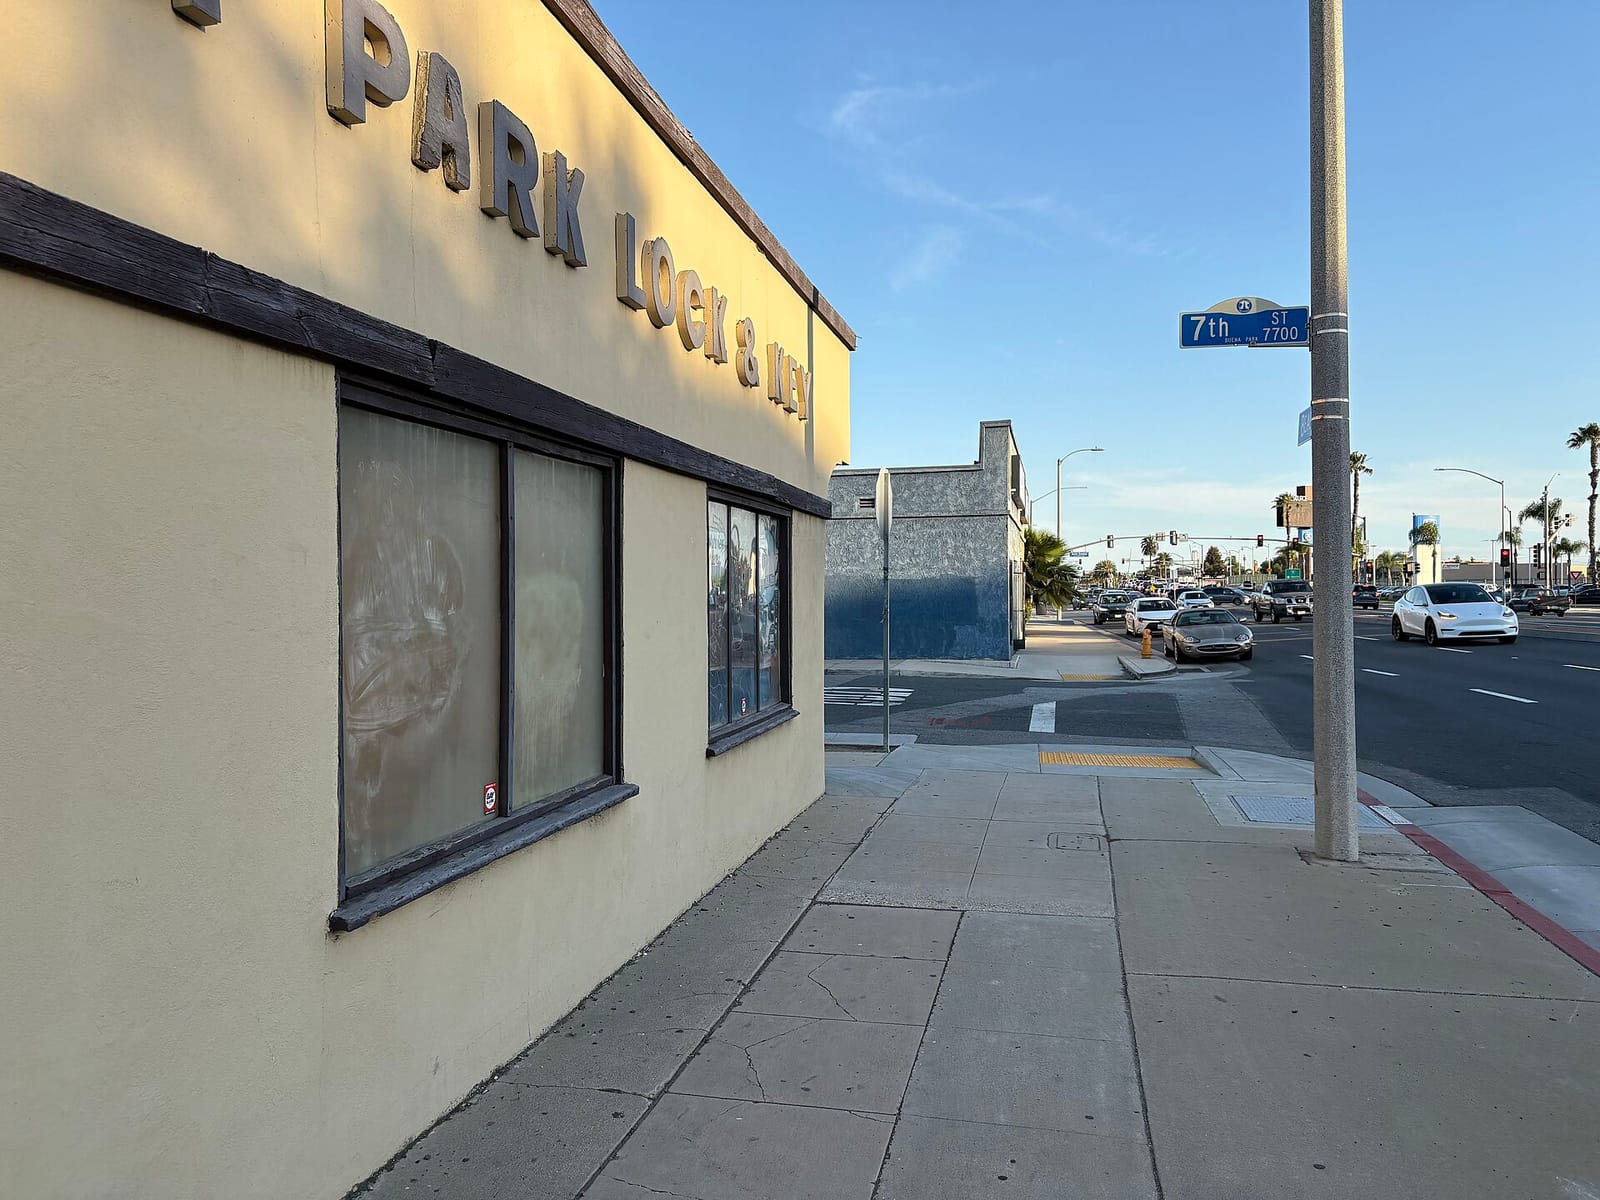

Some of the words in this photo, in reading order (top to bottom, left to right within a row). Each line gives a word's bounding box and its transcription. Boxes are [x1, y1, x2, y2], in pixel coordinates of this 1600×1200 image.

[325, 0, 587, 268] PARK
[615, 213, 728, 364] LOCK
[736, 317, 760, 387] &
[767, 342, 812, 420] KEY
[1190, 315, 1229, 341] 7th
[1271, 311, 1289, 325] ST
[1263, 326, 1299, 342] 7700
